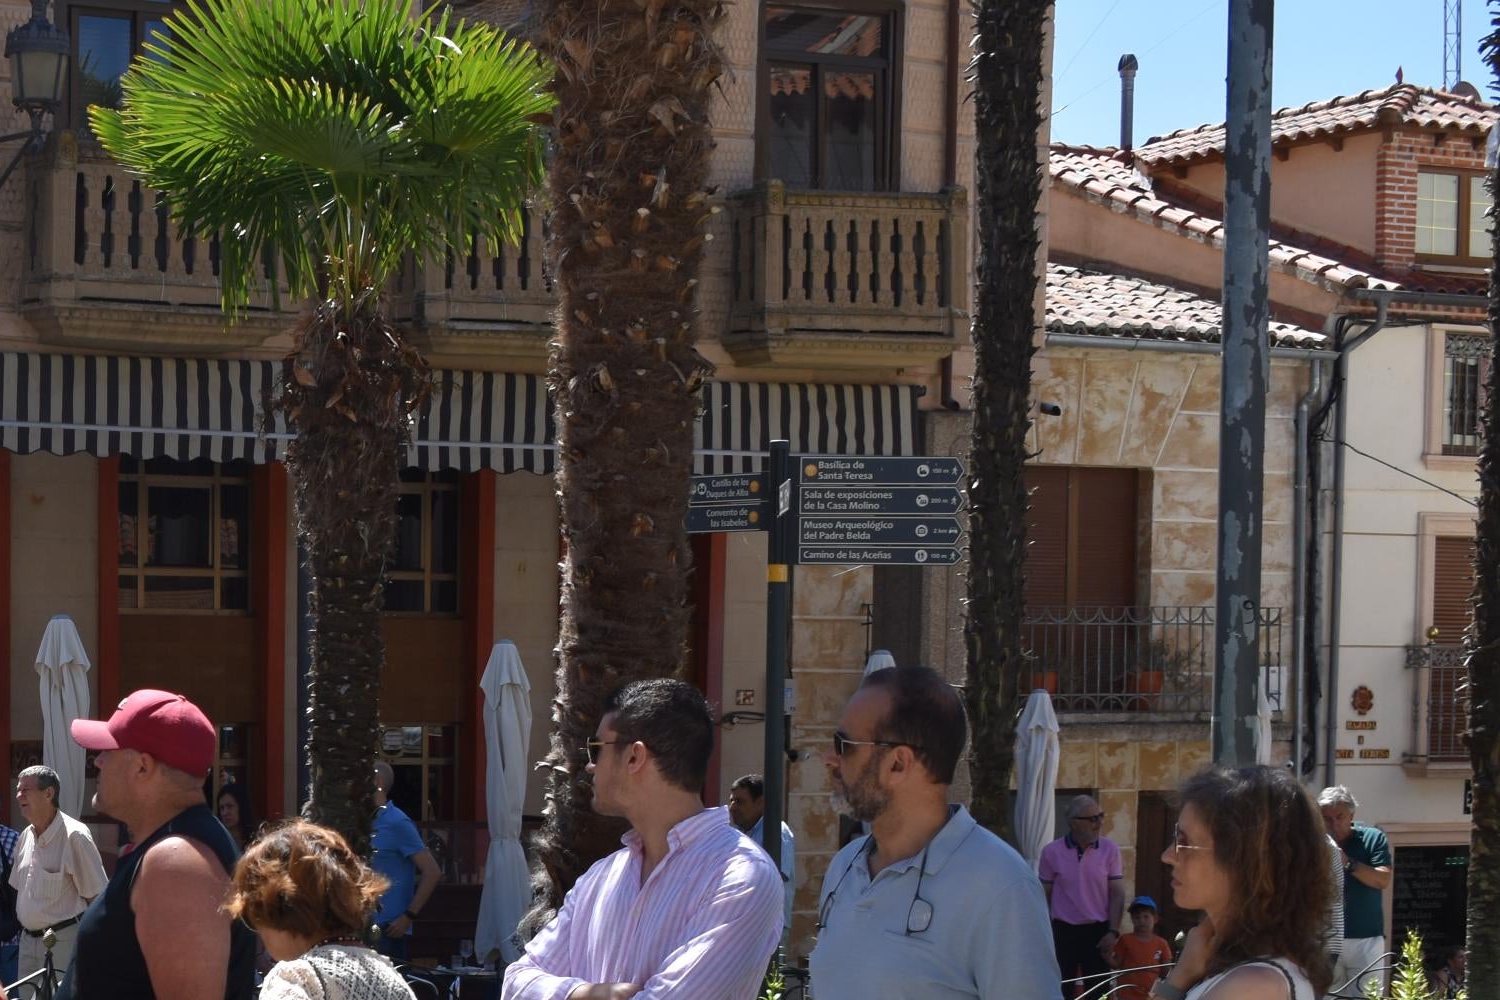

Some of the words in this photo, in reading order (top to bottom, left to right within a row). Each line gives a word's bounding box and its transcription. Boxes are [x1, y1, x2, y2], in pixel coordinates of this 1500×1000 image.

[818, 460, 851, 469] Basílica
[852, 460, 865, 469] de
[818, 471, 843, 480] Santa
[844, 471, 873, 480] Teresa
[732, 478, 740, 487] de
[706, 489, 727, 500] Duques
[727, 488, 736, 497] de
[736, 488, 749, 496] Alba
[804, 490, 822, 499] Sala
[824, 490, 836, 499] de
[837, 490, 893, 501] exposiciones
[804, 501, 815, 510] de
[817, 501, 825, 510] la
[827, 501, 847, 510] Casa
[849, 501, 880, 510] Molino
[706, 509, 739, 517] Convento
[739, 507, 749, 516] de
[710, 519, 720, 528] las
[721, 518, 748, 528] Isabeles
[803, 520, 833, 529] Museo
[835, 520, 894, 532] Arqueológico
[803, 530, 817, 540] del
[819, 530, 845, 540] Padre
[846, 530, 871, 540] Belda
[803, 550, 835, 559] Camino
[836, 550, 847, 559] de
[848, 550, 860, 559] las
[861, 550, 892, 559] Aceñas
